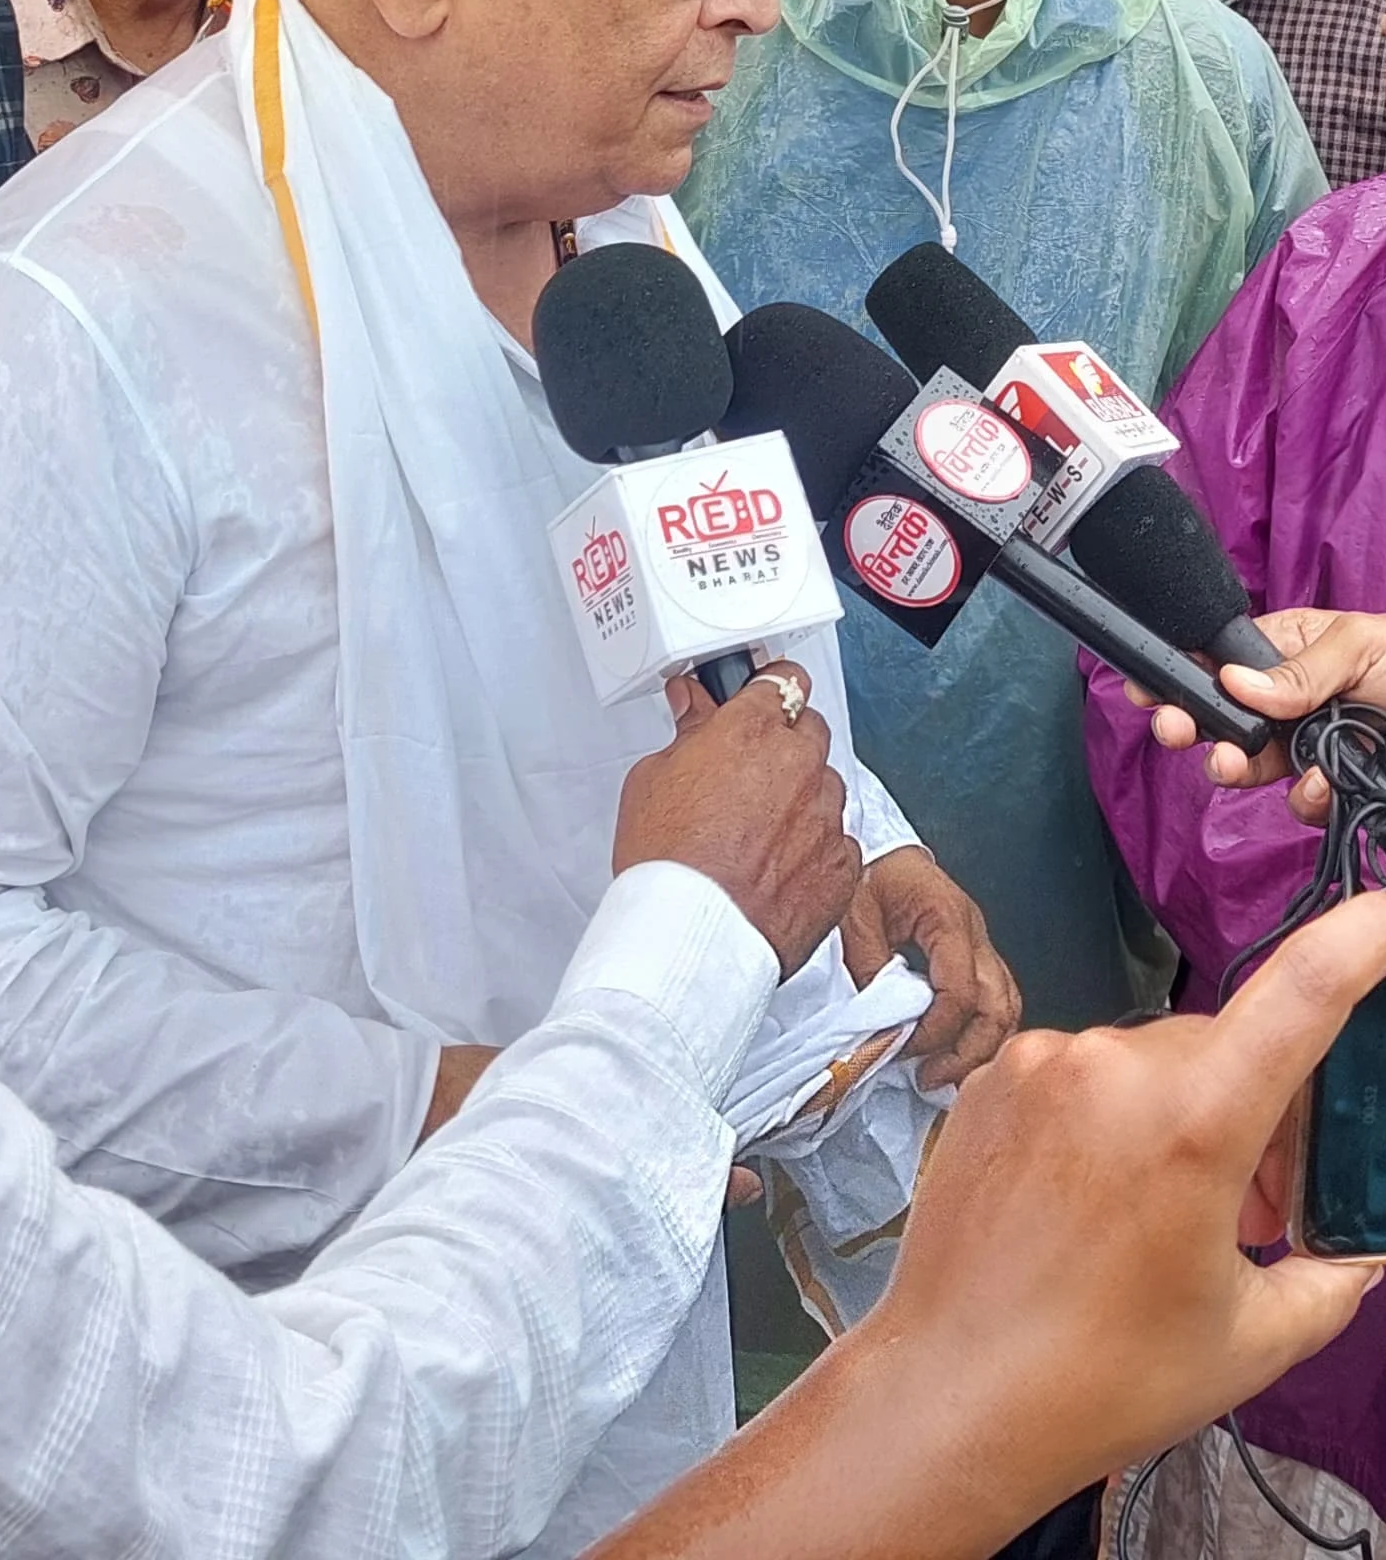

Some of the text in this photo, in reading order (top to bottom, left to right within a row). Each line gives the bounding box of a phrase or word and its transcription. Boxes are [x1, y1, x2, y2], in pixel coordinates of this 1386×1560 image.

[657, 489, 782, 543] RED
[572, 530, 627, 598] RED
[687, 544, 781, 578] NEWS
[860, 506, 930, 589] चिन्तक
[698, 567, 779, 590] BHARAT
[594, 587, 634, 628] NEWS
